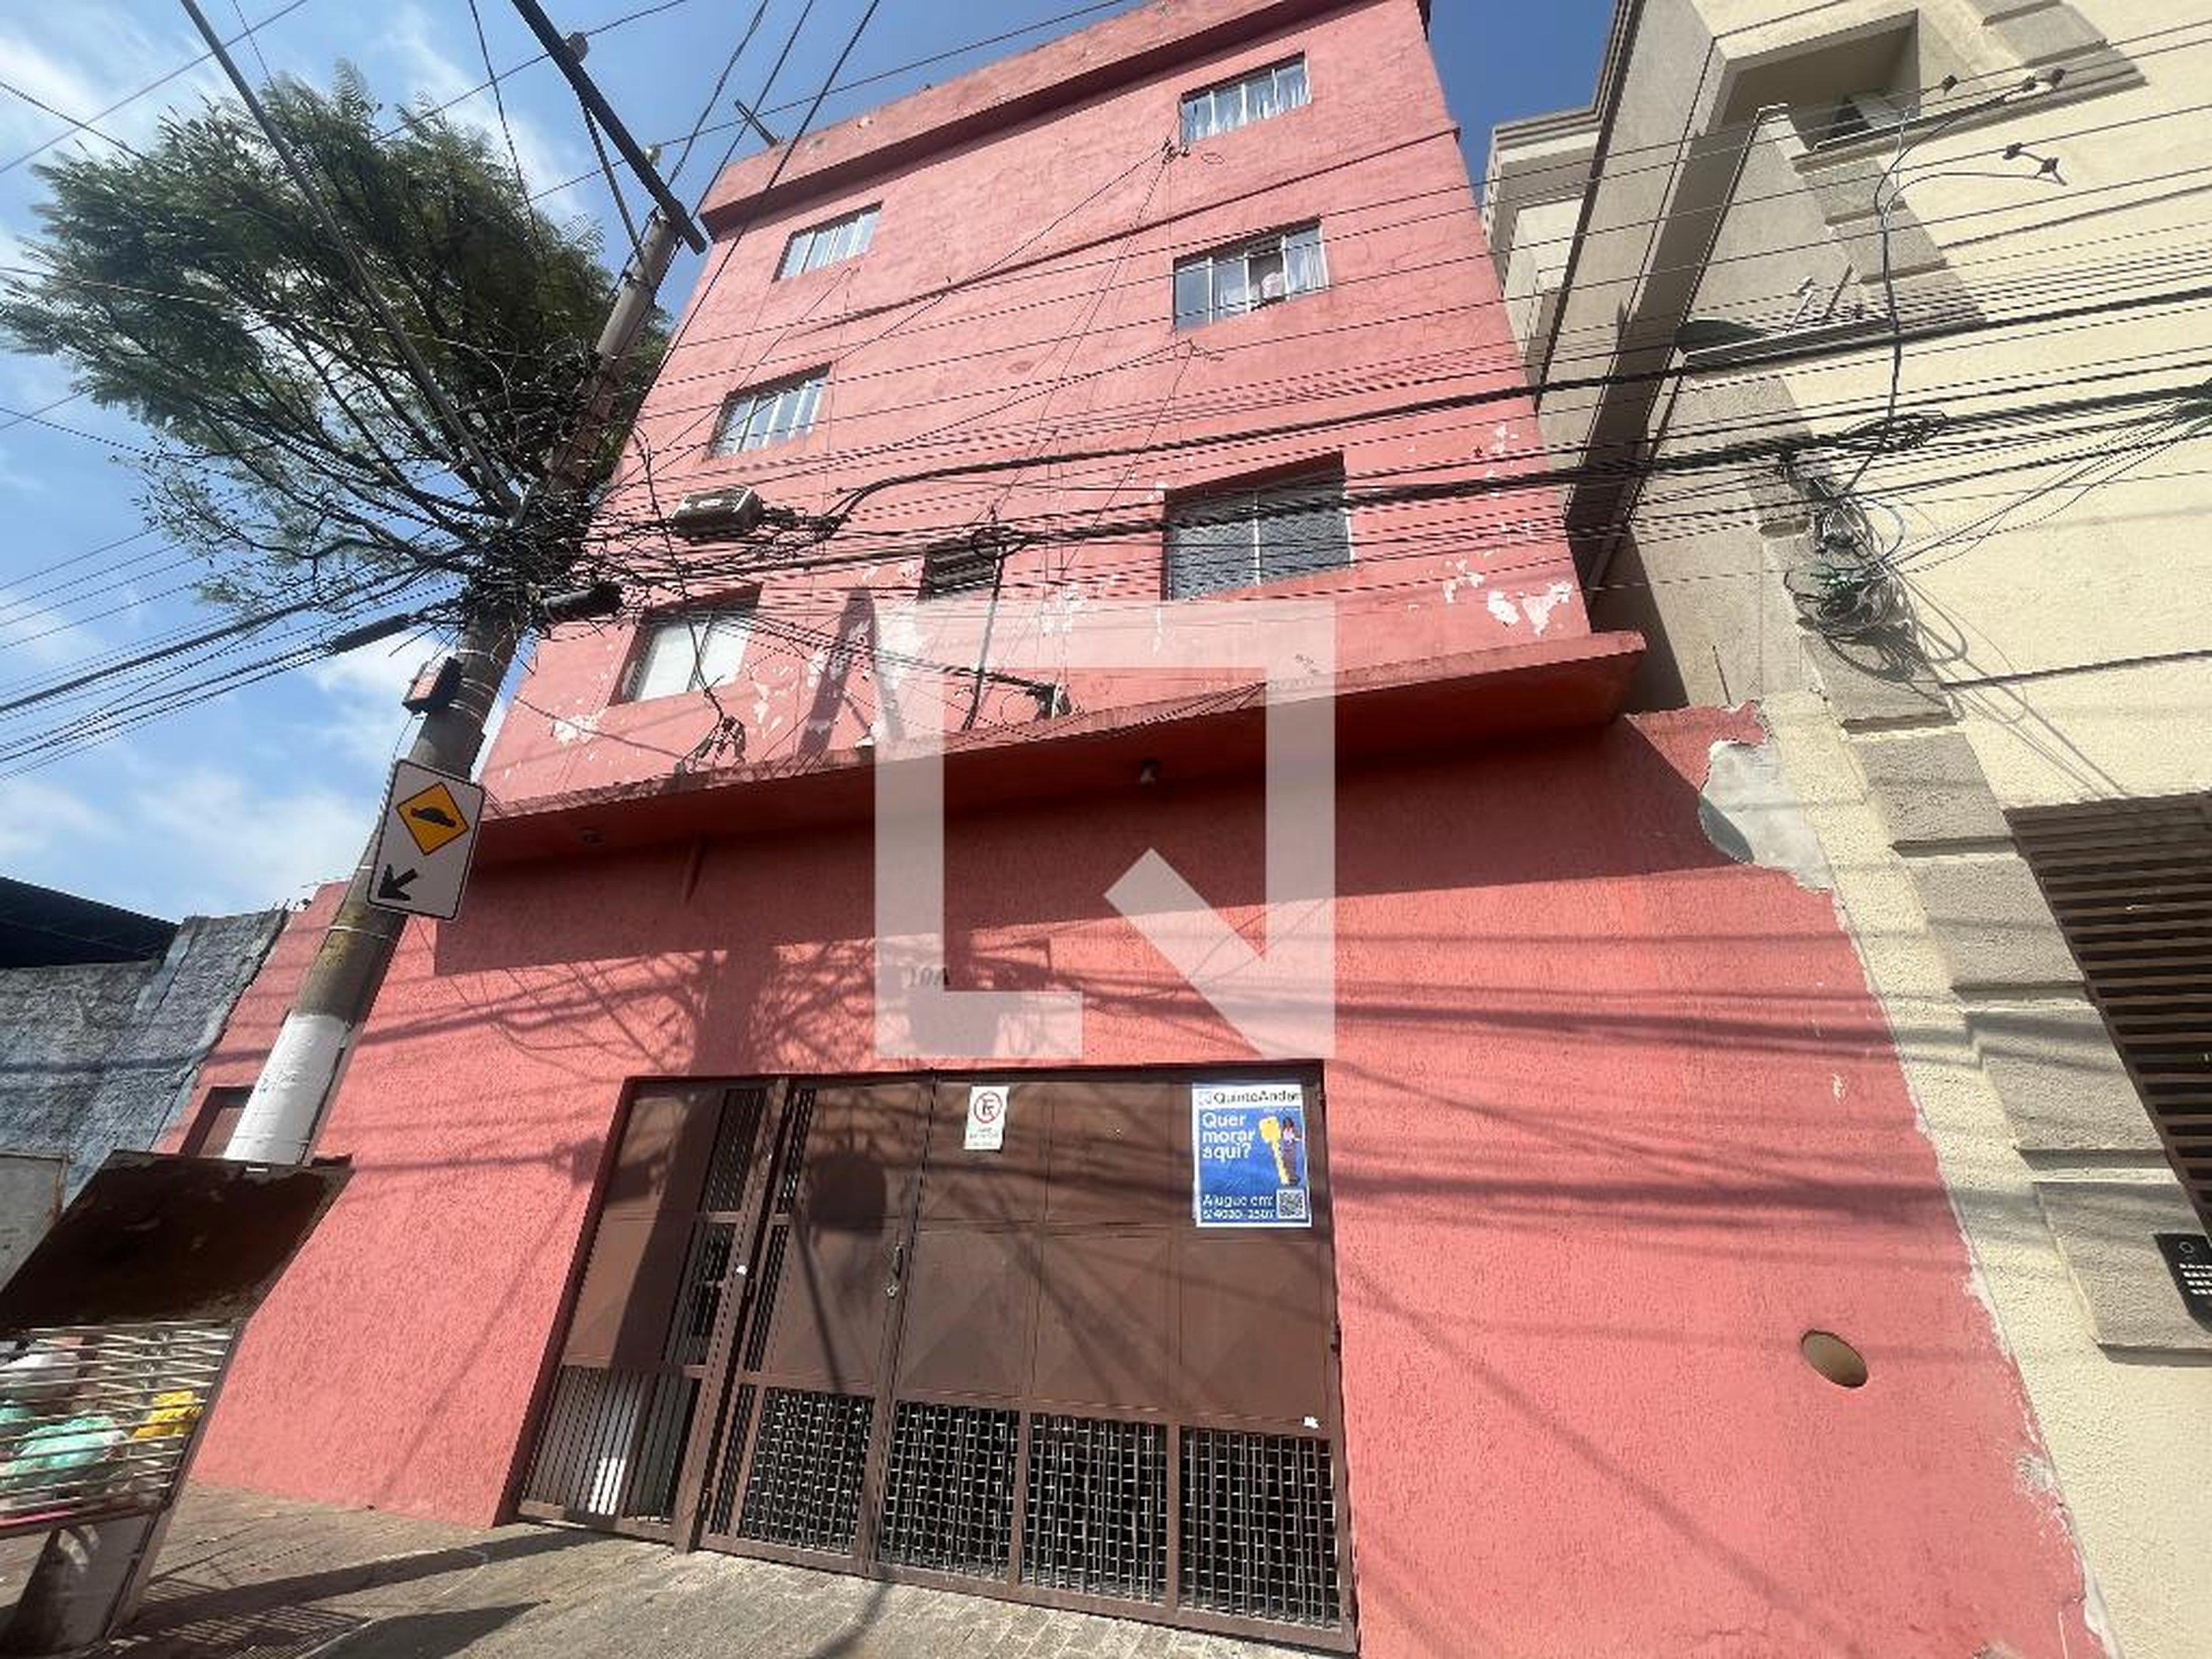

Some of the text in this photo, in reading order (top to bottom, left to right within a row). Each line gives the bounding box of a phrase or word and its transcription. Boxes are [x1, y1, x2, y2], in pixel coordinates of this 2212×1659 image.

[1202, 1112, 1245, 1128] Quer
[1202, 1130, 1255, 1144] morar
[1202, 1143, 1252, 1162] aqui?
